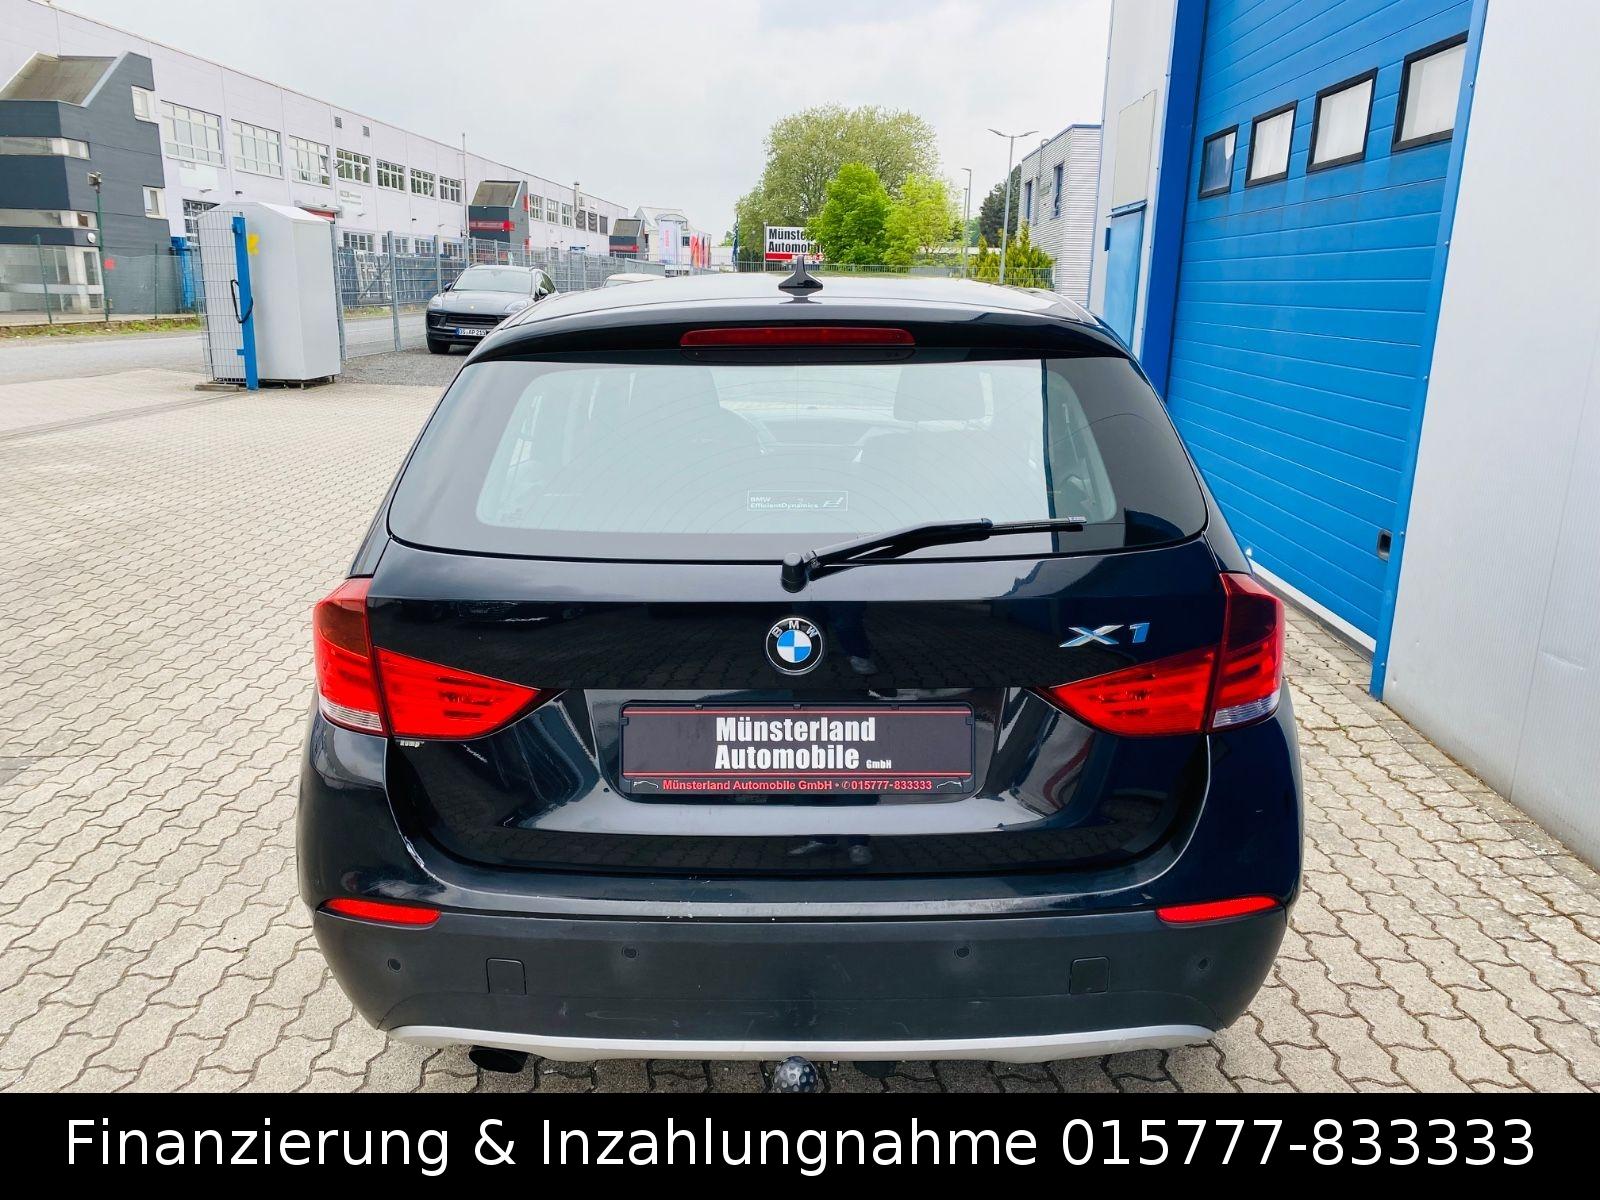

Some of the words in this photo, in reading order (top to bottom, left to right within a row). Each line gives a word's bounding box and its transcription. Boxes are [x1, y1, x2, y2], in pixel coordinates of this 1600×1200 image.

[768, 228, 806, 241] Münste
[771, 620, 819, 639] BMW
[1059, 622, 1150, 648] X1
[716, 716, 876, 742] Münsterland
[715, 744, 859, 770] Automobile
[866, 759, 892, 770] GmbH
[663, 779, 730, 791] Münsterland
[733, 780, 796, 791] Automobile
[798, 780, 833, 791] GmbH
[851, 780, 933, 791] 015777-833333
